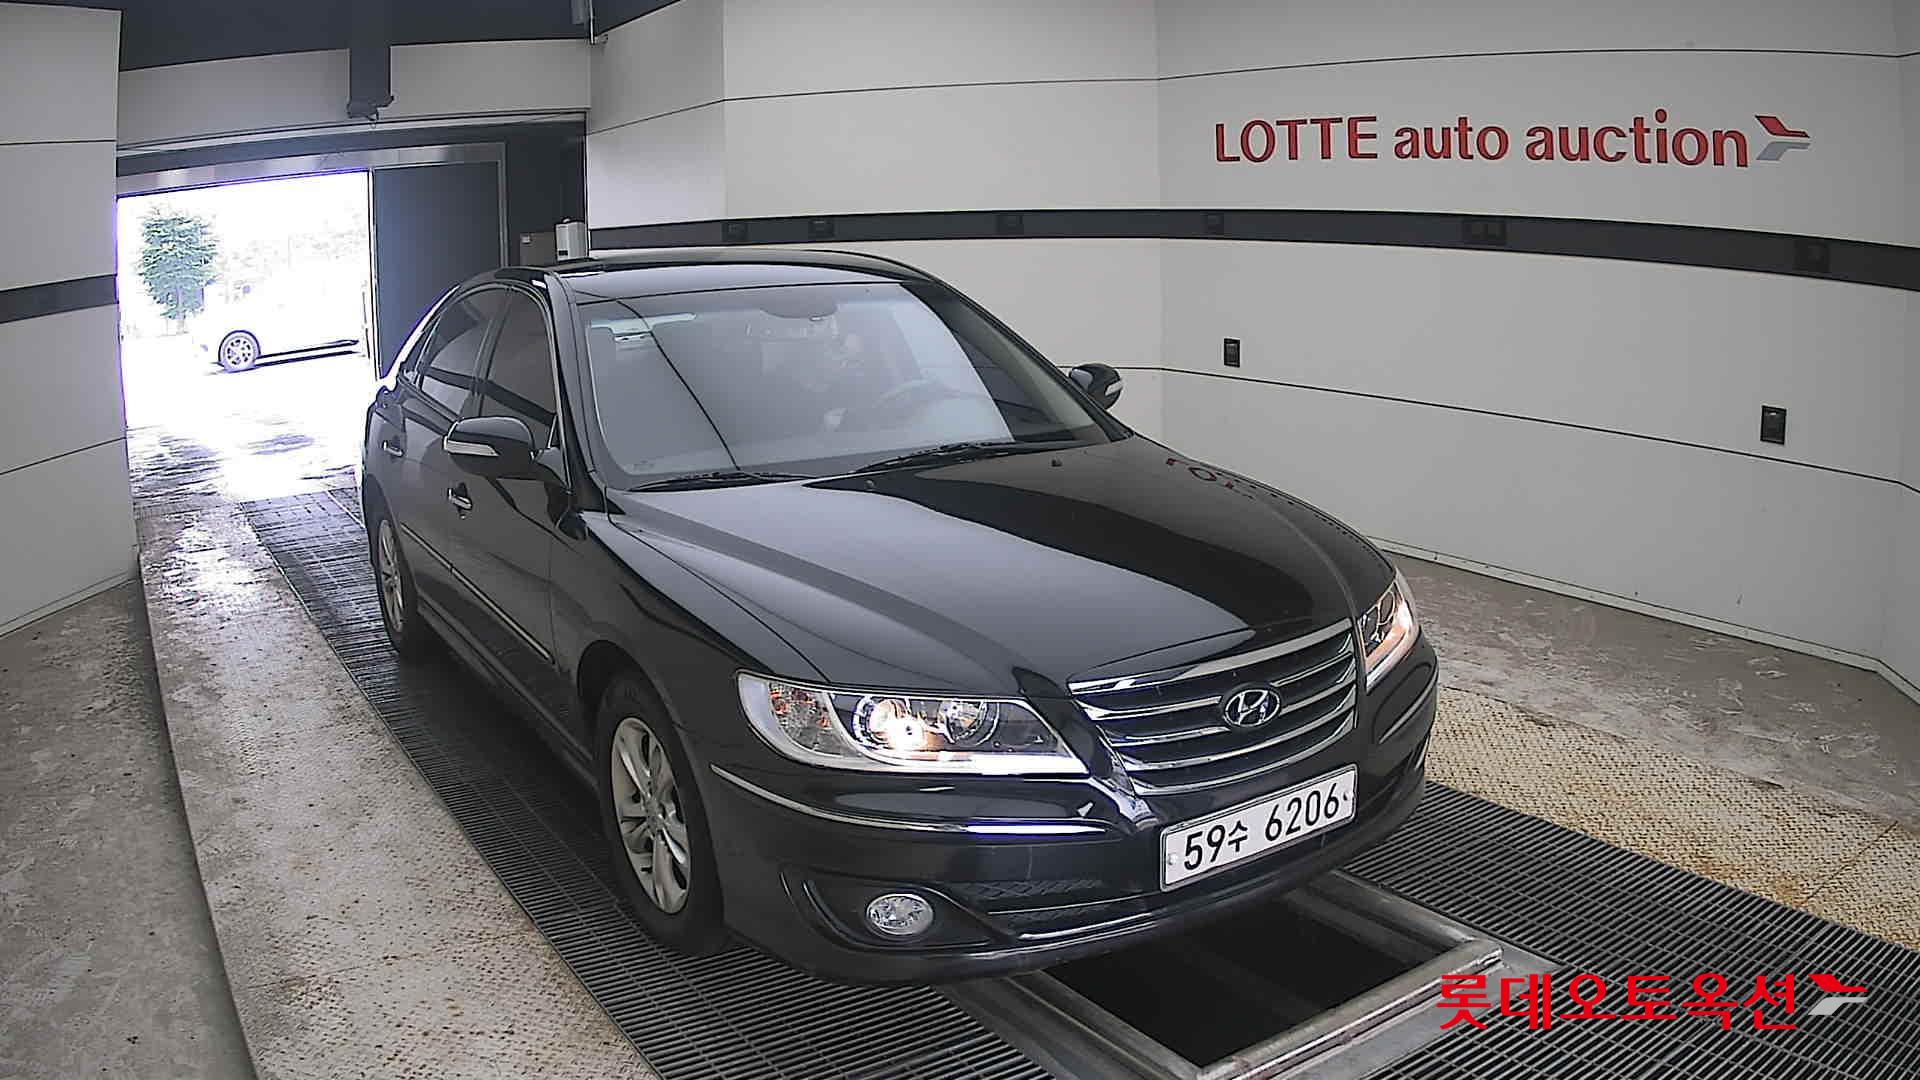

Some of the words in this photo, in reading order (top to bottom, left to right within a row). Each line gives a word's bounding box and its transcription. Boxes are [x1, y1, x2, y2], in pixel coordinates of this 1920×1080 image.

[1215, 115, 1378, 162] LOTTE
[1394, 116, 1510, 161] auto
[1524, 108, 1750, 167] auction
[1183, 820, 1249, 871] 59수
[1264, 782, 1340, 842] 6206
